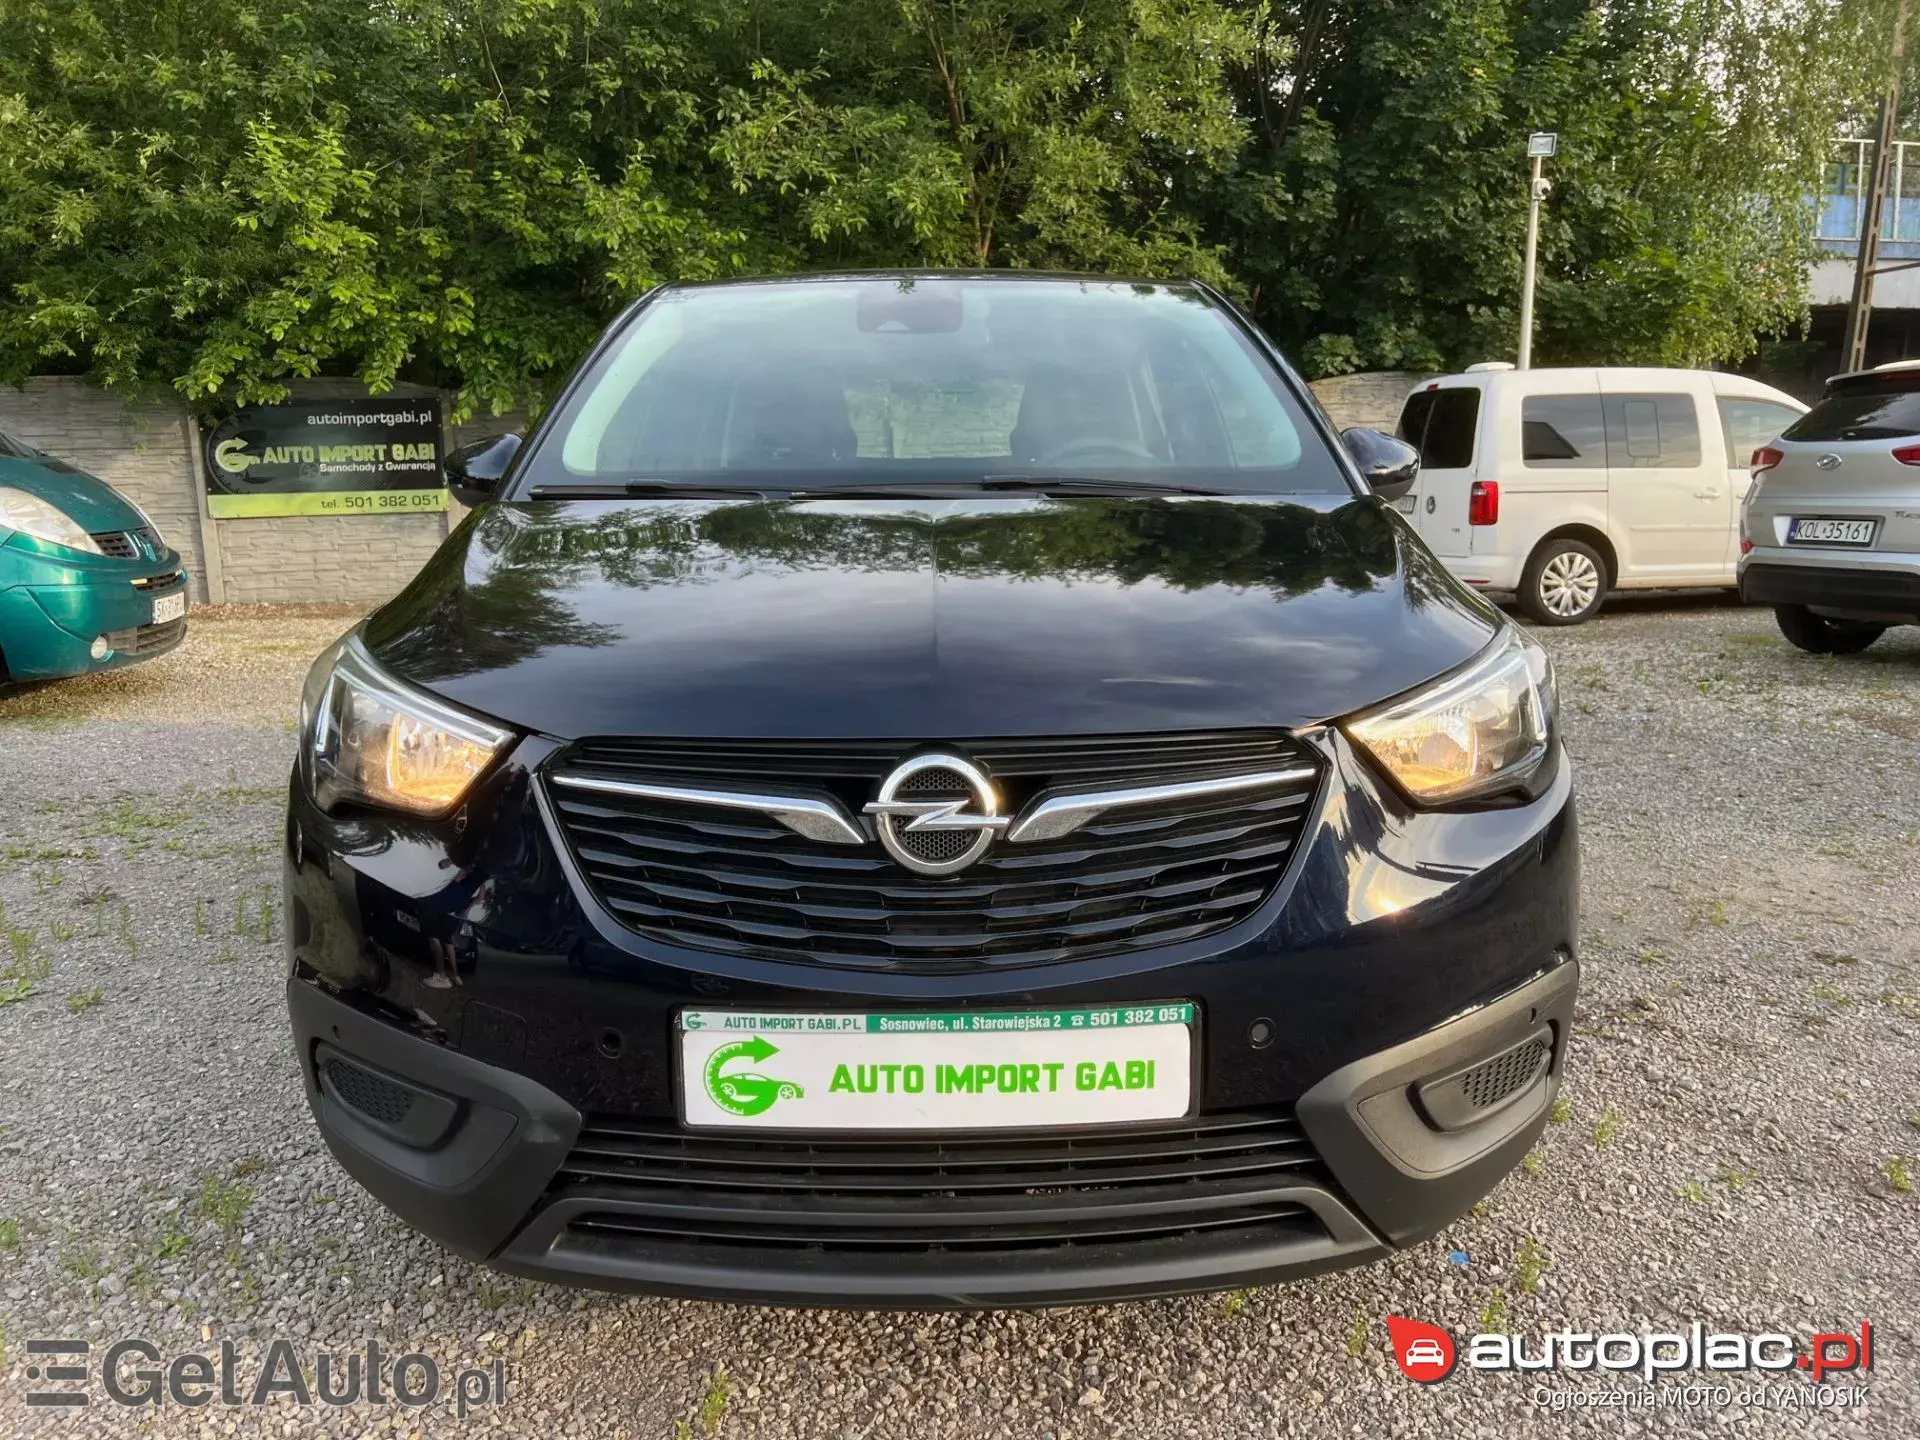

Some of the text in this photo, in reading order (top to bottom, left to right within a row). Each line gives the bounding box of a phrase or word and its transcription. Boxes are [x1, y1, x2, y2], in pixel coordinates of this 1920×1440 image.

[307, 411, 432, 427] autoimportgabi.pl
[263, 443, 435, 464] AUTO IMPORT GABI
[319, 462, 376, 473] Samochody
[385, 462, 436, 472] Gwarancją
[321, 494, 440, 509] tel. 501 382 051
[1825, 522, 1870, 540] 35161
[724, 1016, 862, 1030] AUTO IMPORT GABI.PL
[879, 1007, 1187, 1032] Sosnowiec, ul. Starowiejska 2 501 382 051
[828, 1060, 1155, 1094] AUTO IMPORT GABI
